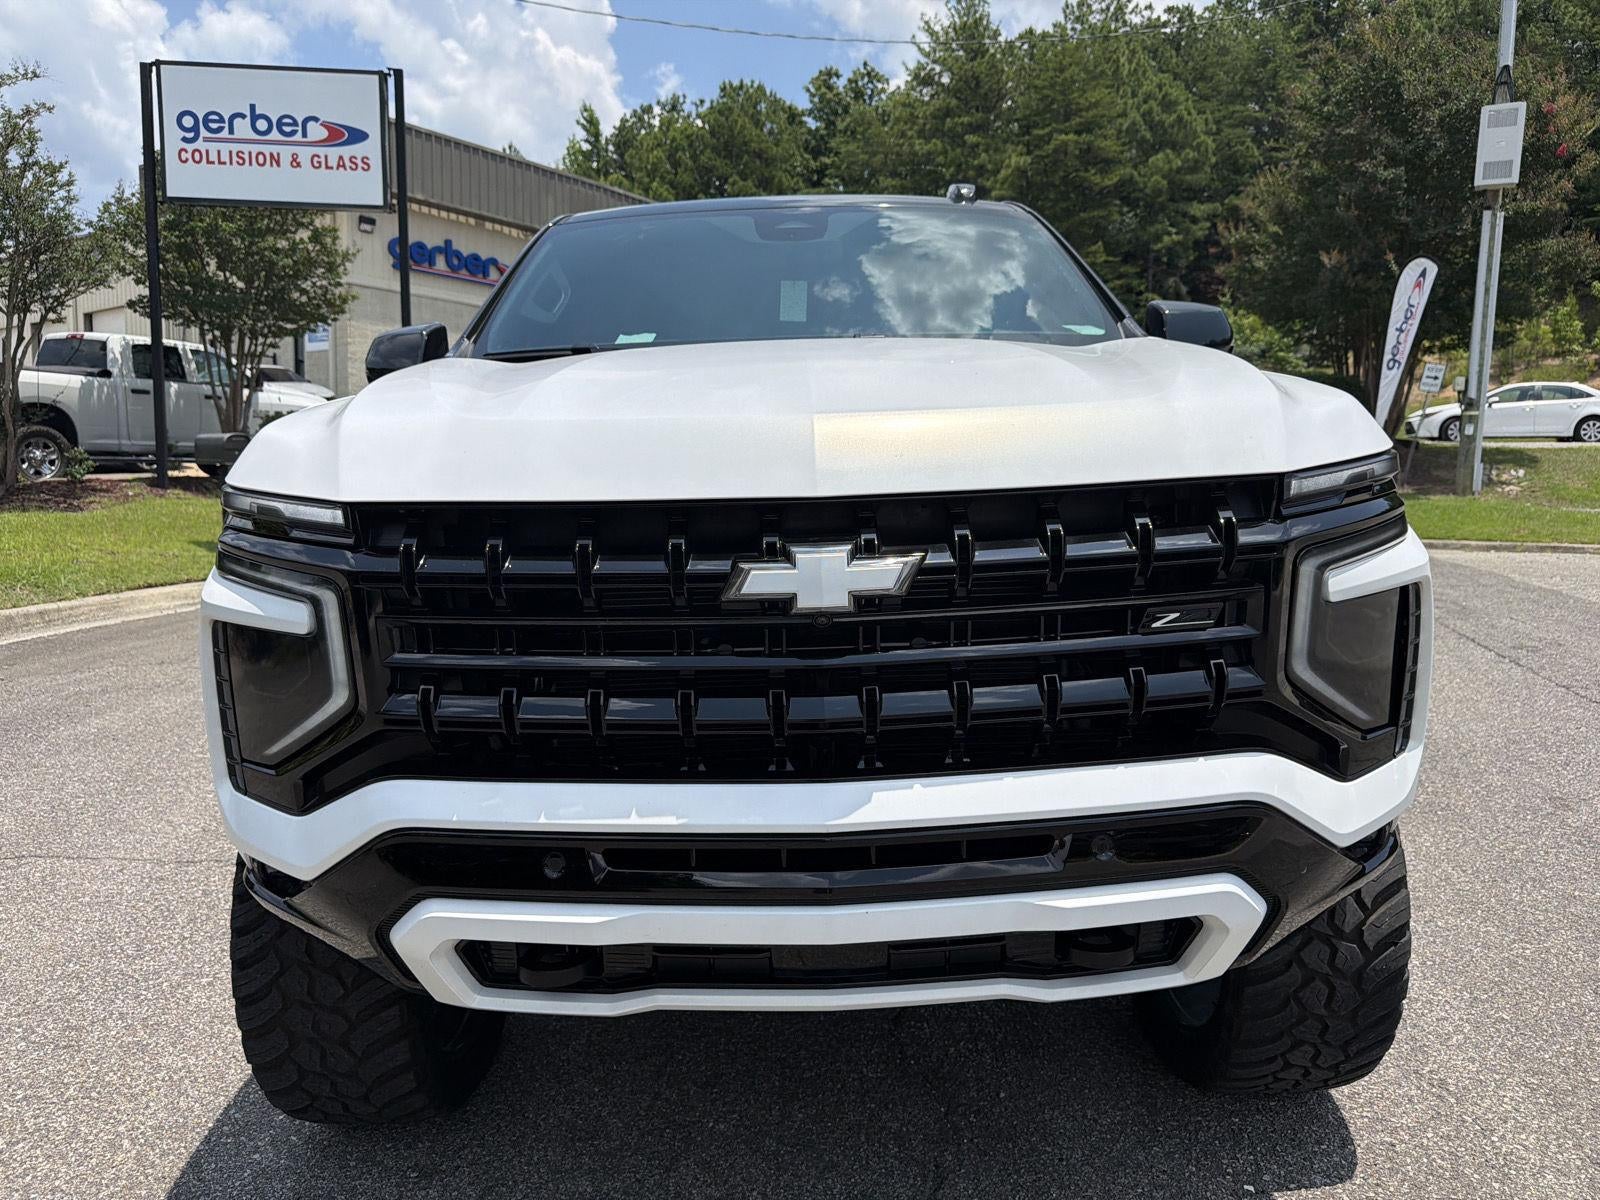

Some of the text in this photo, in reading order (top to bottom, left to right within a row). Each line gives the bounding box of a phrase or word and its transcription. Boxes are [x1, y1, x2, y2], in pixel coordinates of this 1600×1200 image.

[176, 103, 320, 144] gerber
[177, 147, 371, 172] COLLISION & GLASS
[1386, 295, 1416, 371] gerber
